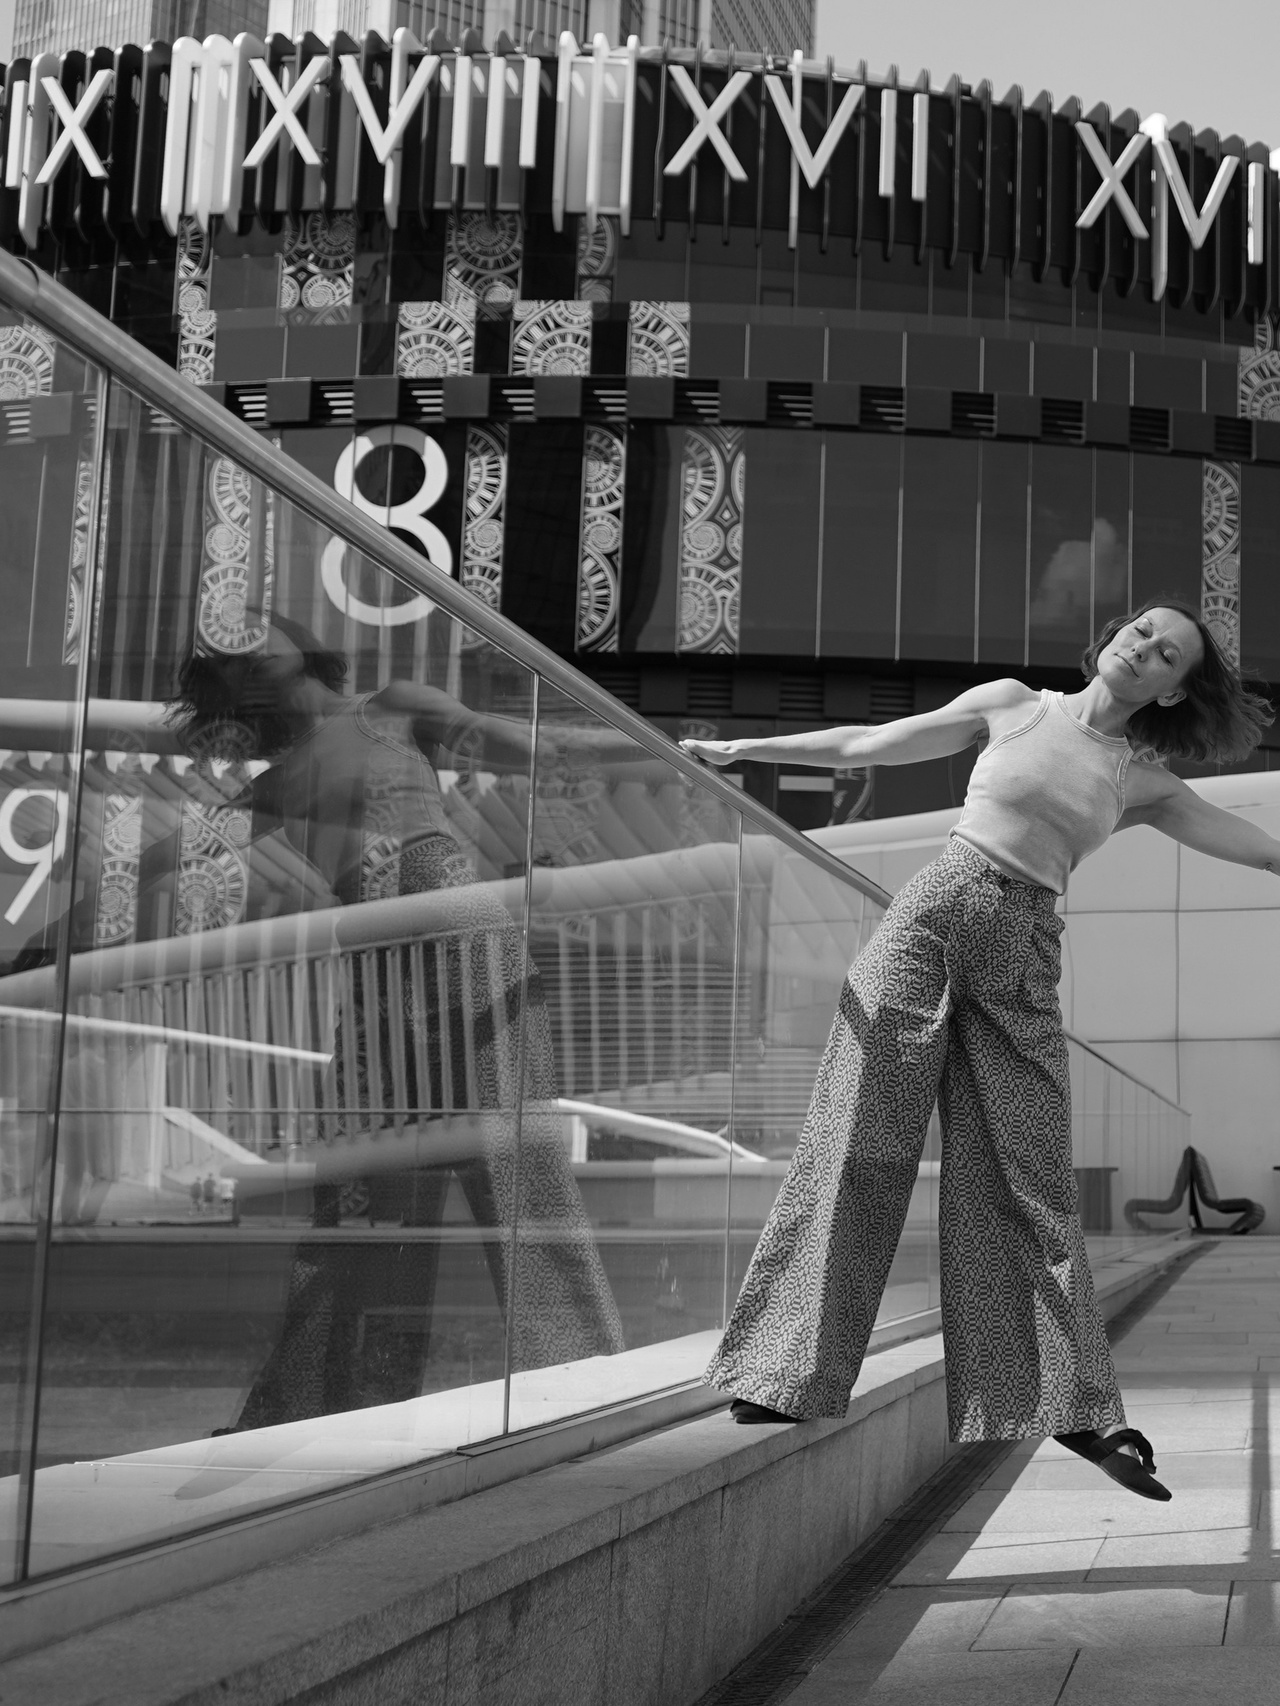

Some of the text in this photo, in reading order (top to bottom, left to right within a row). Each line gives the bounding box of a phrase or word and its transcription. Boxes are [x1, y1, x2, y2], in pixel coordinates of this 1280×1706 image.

[242, 54, 541, 169] XVIII
[663, 65, 930, 201] XVII
[1074, 120, 1265, 265] XVI
[0, 787, 69, 925] 9
